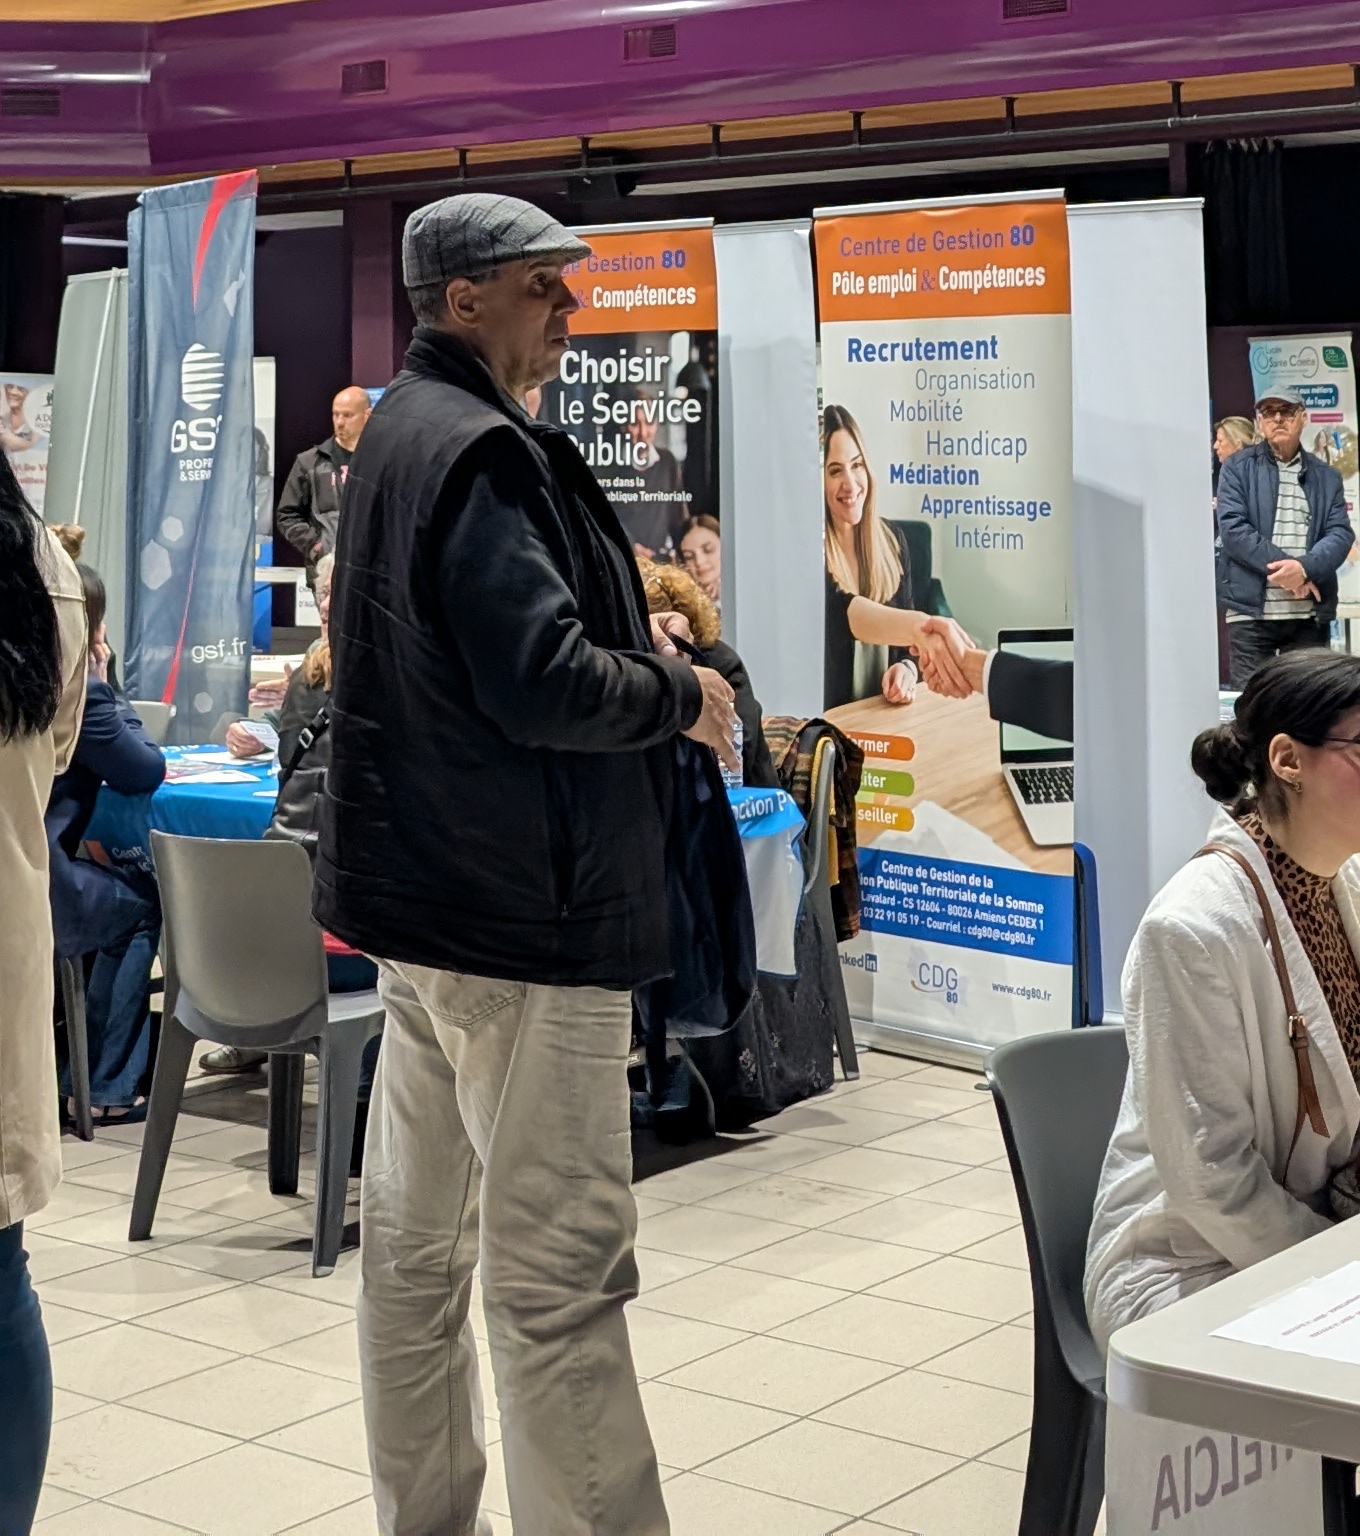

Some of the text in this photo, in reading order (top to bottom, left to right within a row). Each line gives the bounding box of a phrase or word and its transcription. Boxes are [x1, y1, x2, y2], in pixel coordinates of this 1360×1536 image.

[840, 224, 1035, 257] Centre de Gestion 80
[587, 251, 655, 273] Gestion
[661, 249, 686, 269] 80
[832, 263, 1046, 299] Pôle emploi & Compétences
[592, 283, 696, 312] Compétences
[847, 335, 999, 363] Recrutement
[559, 347, 670, 385] Choisir
[915, 366, 1036, 397] Organisation
[559, 390, 702, 425] le Service
[890, 398, 963, 422] Mobilité
[926, 430, 1028, 463] Handicap
[613, 476, 635, 488] dans
[636, 476, 646, 488] la
[890, 462, 980, 486] Médiation
[606, 490, 693, 504] ublique Territoriale
[920, 493, 1052, 522] Apprentissage
[955, 525, 1024, 551] Intérim
[192, 637, 247, 662] gsf.fr
[861, 771, 887, 789] iter
[881, 859, 993, 889] Centre de Gestion de la
[877, 875, 919, 895] Publique
[921, 882, 977, 903] Territoriale
[979, 892, 992, 905] de
[994, 893, 1004, 907] la
[1005, 895, 1044, 914] Somme
[861, 890, 895, 906] Lavalard
[903, 897, 914, 909] CS
[916, 899, 940, 913] 12604
[947, 904, 972, 918] 80026
[974, 909, 1006, 924] Amiens
[1008, 914, 1037, 930] CEDEX
[1039, 919, 1043, 931] 1
[863, 906, 873, 918] 03
[875, 908, 885, 920] 22
[886, 910, 895, 922] 91
[897, 912, 908, 924] 05
[909, 914, 919, 926] 19
[926, 917, 961, 933] Courriel
[967, 925, 1035, 945] cdg80@cdg80.fr
[919, 962, 958, 990] CDG
[992, 982, 1052, 1002] www.cdg80.fr
[946, 991, 959, 1004] 80
